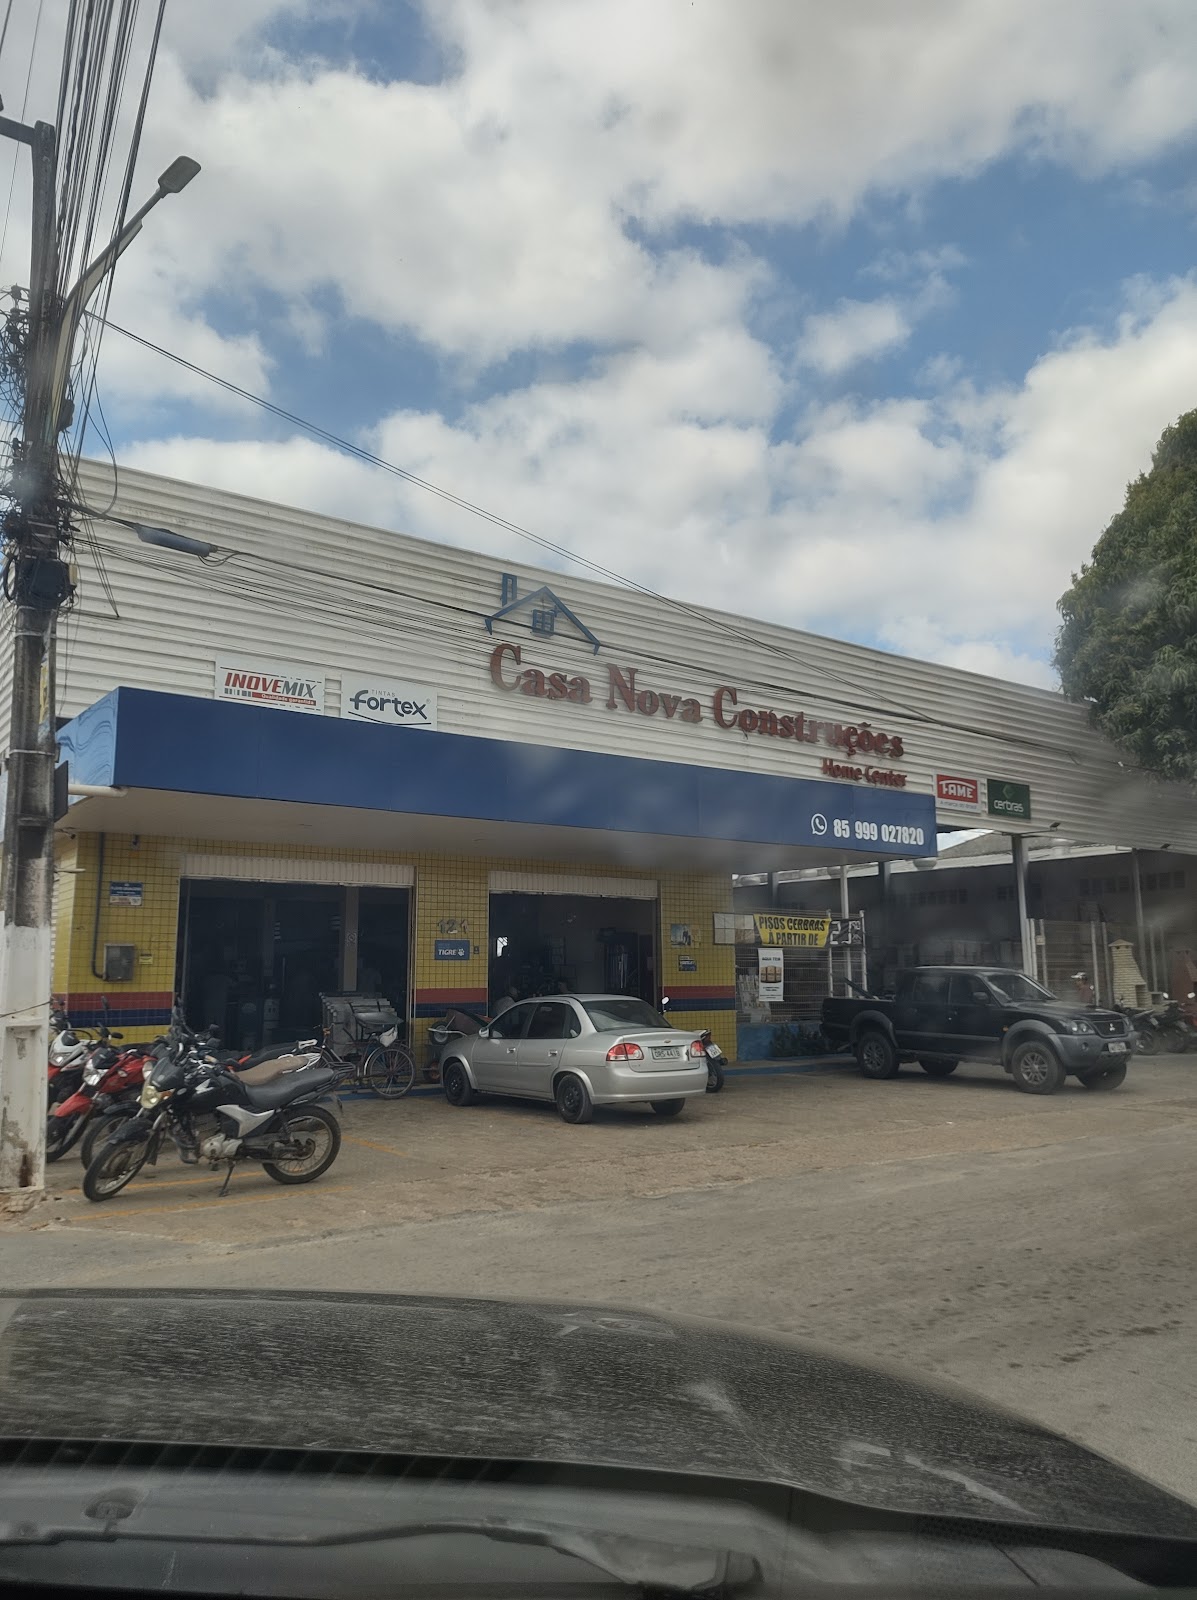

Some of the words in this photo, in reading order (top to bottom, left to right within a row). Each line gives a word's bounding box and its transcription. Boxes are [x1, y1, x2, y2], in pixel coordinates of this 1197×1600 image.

[224, 672, 317, 698] INOVEMIX
[371, 689, 396, 697] TINTAS
[490, 643, 593, 704] Casa
[605, 663, 703, 723] Nova
[713, 686, 904, 757] Construções
[821, 758, 862, 781] Home
[864, 765, 907, 787] Center
[939, 780, 976, 799] FAME
[833, 819, 850, 838] 85
[855, 821, 878, 841] 999
[881, 824, 924, 846] 027820
[437, 919, 470, 934] 121
[758, 916, 785, 930] PISOS
[787, 918, 826, 931] CERBRAS
[776, 932, 807, 945] PARTIR
[808, 934, 819, 946] DE
[438, 948, 457, 956] TIGRE
